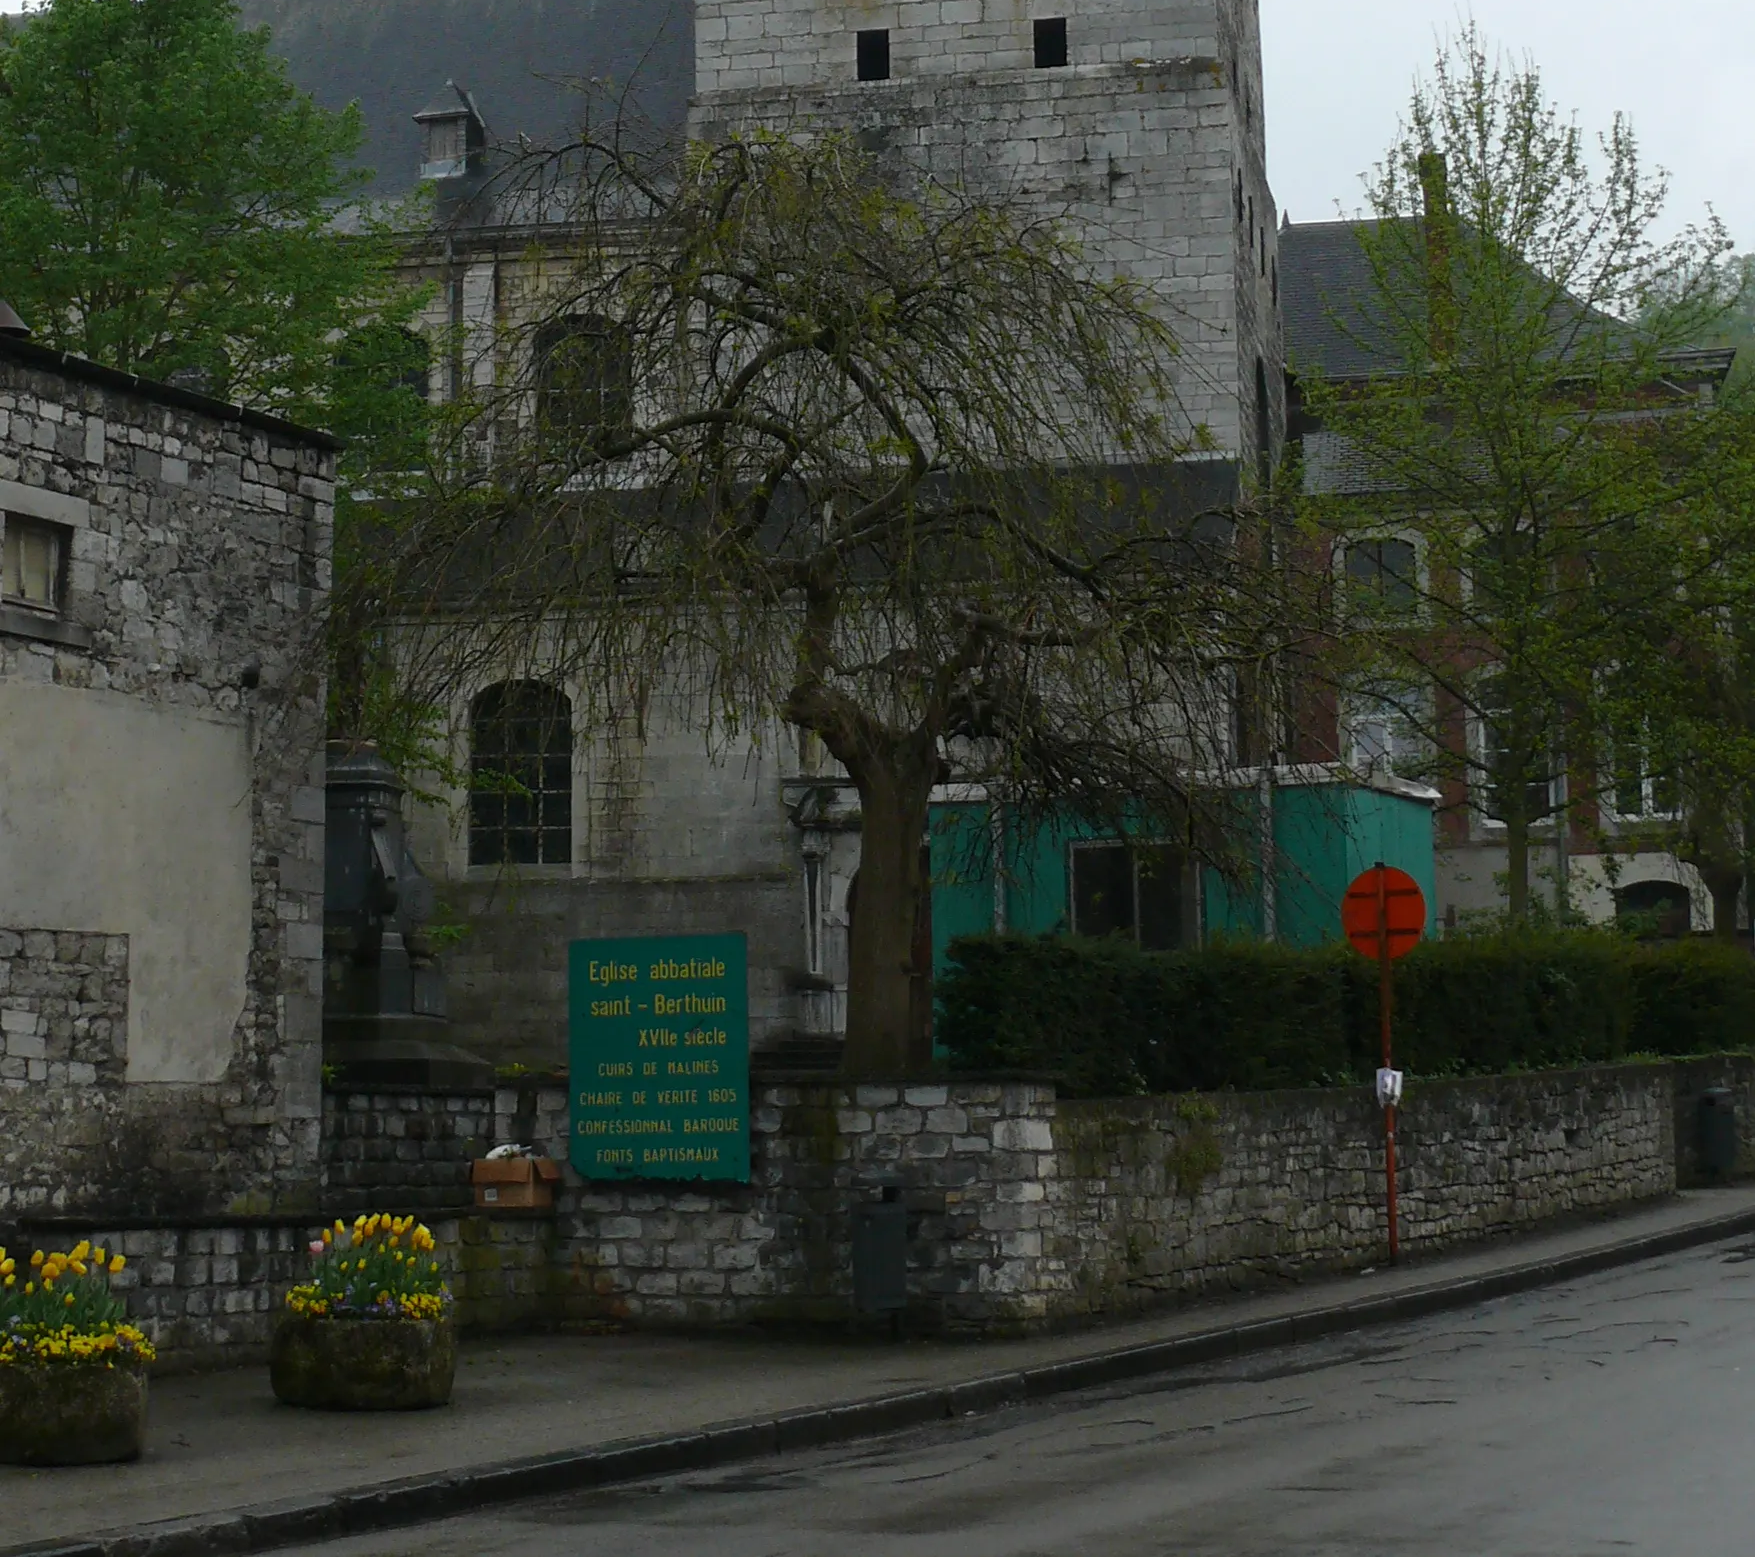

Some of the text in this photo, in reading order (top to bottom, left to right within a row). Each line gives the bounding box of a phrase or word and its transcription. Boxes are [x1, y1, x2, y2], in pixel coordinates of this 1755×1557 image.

[589, 957, 726, 987] Eglise abbatiale
[591, 995, 631, 1016] saint
[654, 992, 726, 1015] Berthuin
[684, 1027, 726, 1045] siècle
[598, 1060, 719, 1076] CUIRS DE MALINES
[580, 1089, 736, 1106] CHAIRE DE VERITE 1605
[578, 1118, 740, 1134] CONFESSIONNAL BAROQUE
[596, 1147, 719, 1163] FONTS BAPTISMAUX
